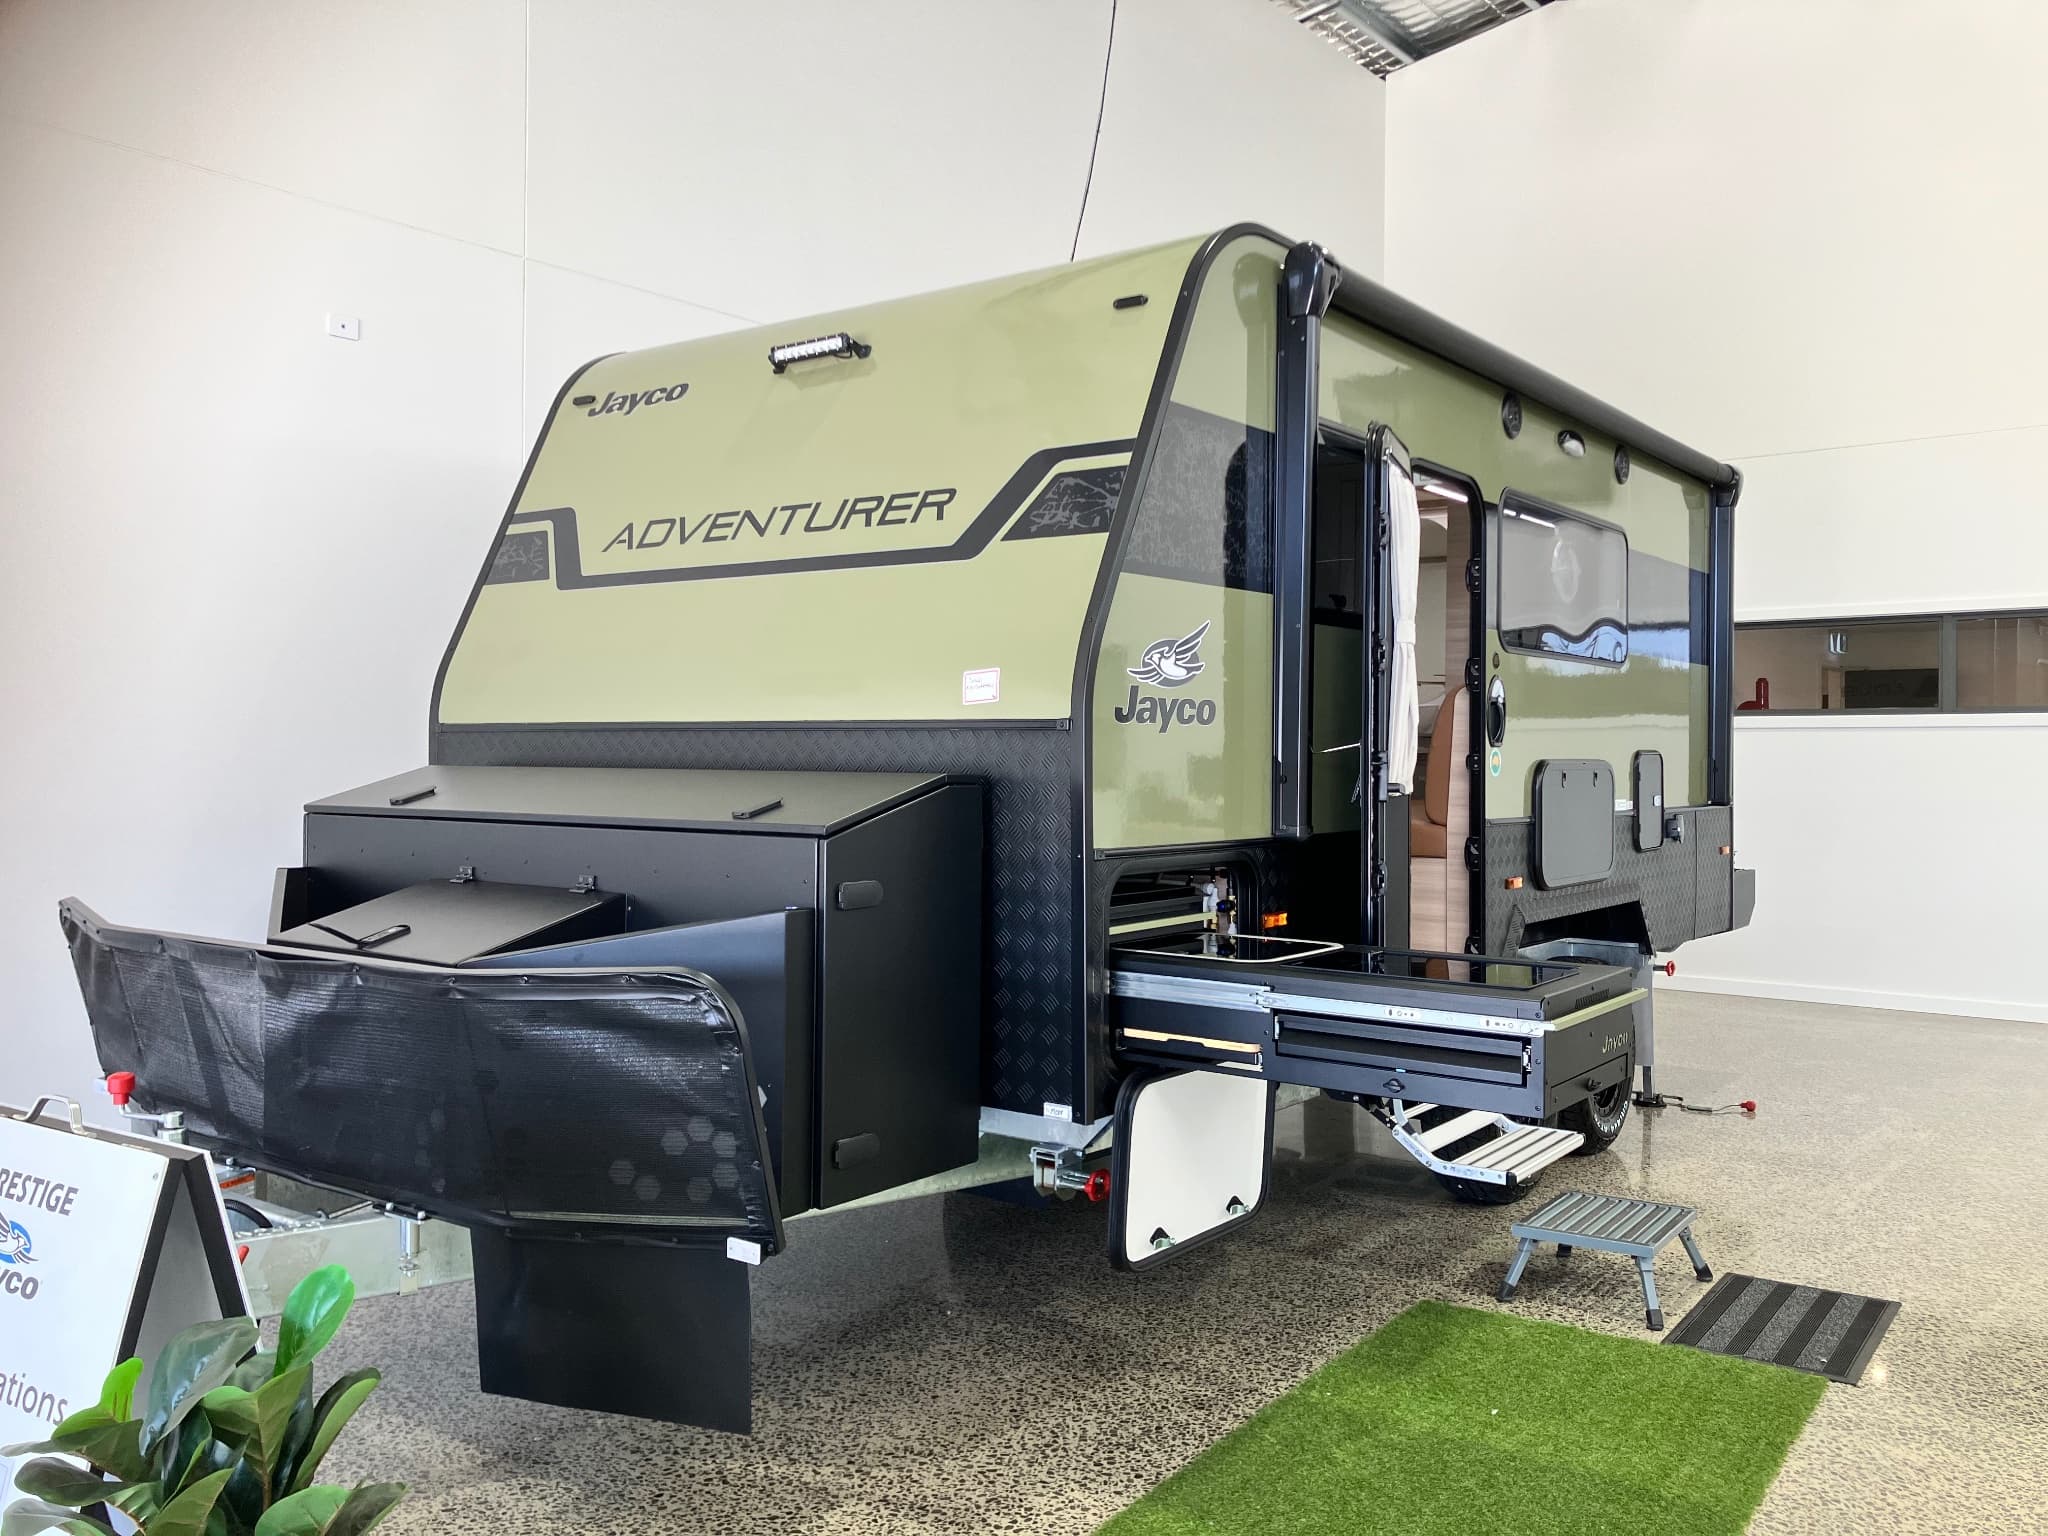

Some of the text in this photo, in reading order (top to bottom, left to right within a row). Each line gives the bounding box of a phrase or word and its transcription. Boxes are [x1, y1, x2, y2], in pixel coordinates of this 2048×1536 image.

[588, 383, 689, 417] Jayco
[601, 488, 957, 552] ADVENTURER
[1114, 685, 1216, 733] Jayco
